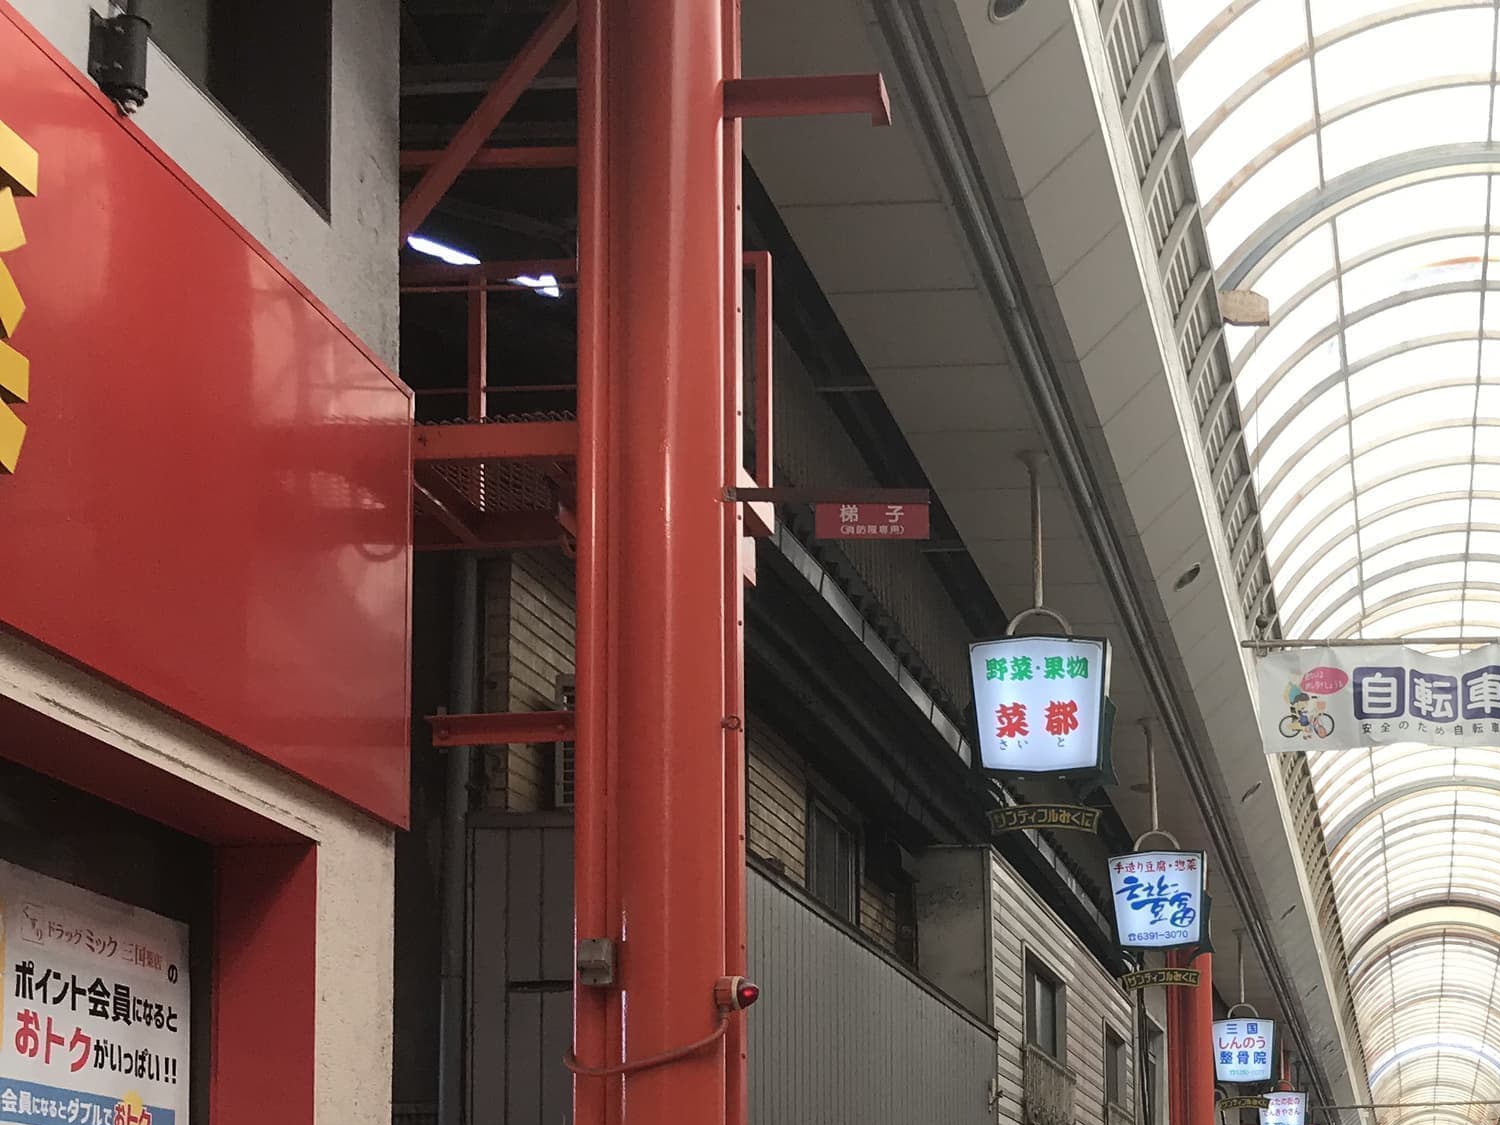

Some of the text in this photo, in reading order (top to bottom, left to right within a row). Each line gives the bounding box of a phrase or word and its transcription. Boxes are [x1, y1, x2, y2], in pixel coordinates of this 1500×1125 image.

[985, 656, 1090, 681] 野菜・果物
[995, 700, 1079, 739] 菜都
[14, 960, 178, 1033] ポイント会員になると
[1226, 1022, 1259, 1035] 三国
[1218, 1036, 1266, 1050] しんのう
[1219, 1051, 1267, 1065] 整骨院
